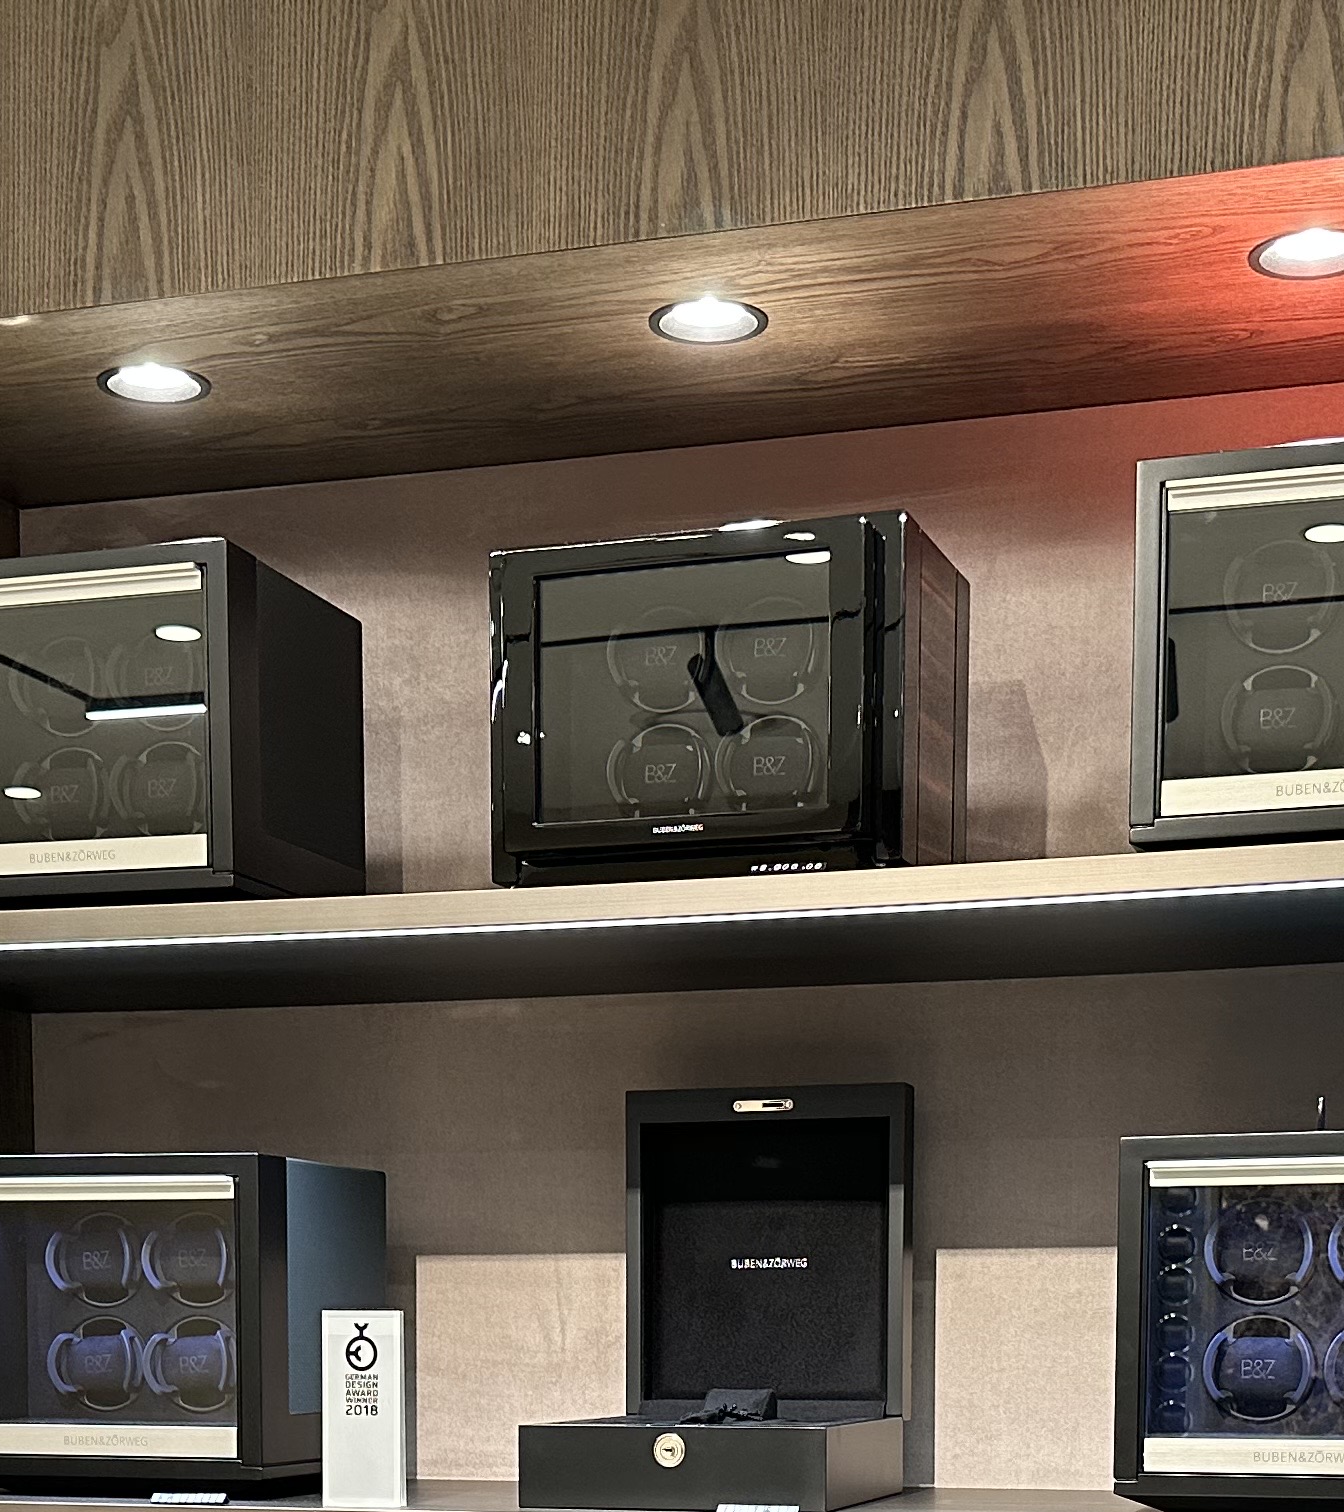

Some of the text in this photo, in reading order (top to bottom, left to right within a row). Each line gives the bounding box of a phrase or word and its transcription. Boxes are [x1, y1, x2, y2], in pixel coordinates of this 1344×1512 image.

[1260, 708, 1296, 729] B&Z
[645, 764, 677, 783] B&Z
[753, 756, 786, 776] B&Z
[83, 1251, 110, 1270] B&Z
[180, 1356, 209, 1374] B&Z
[1241, 1359, 1276, 1380] B&Z
[346, 1381, 378, 1389] DESIGN
[346, 1389, 378, 1397] AWARD
[346, 1405, 378, 1416] 2018
